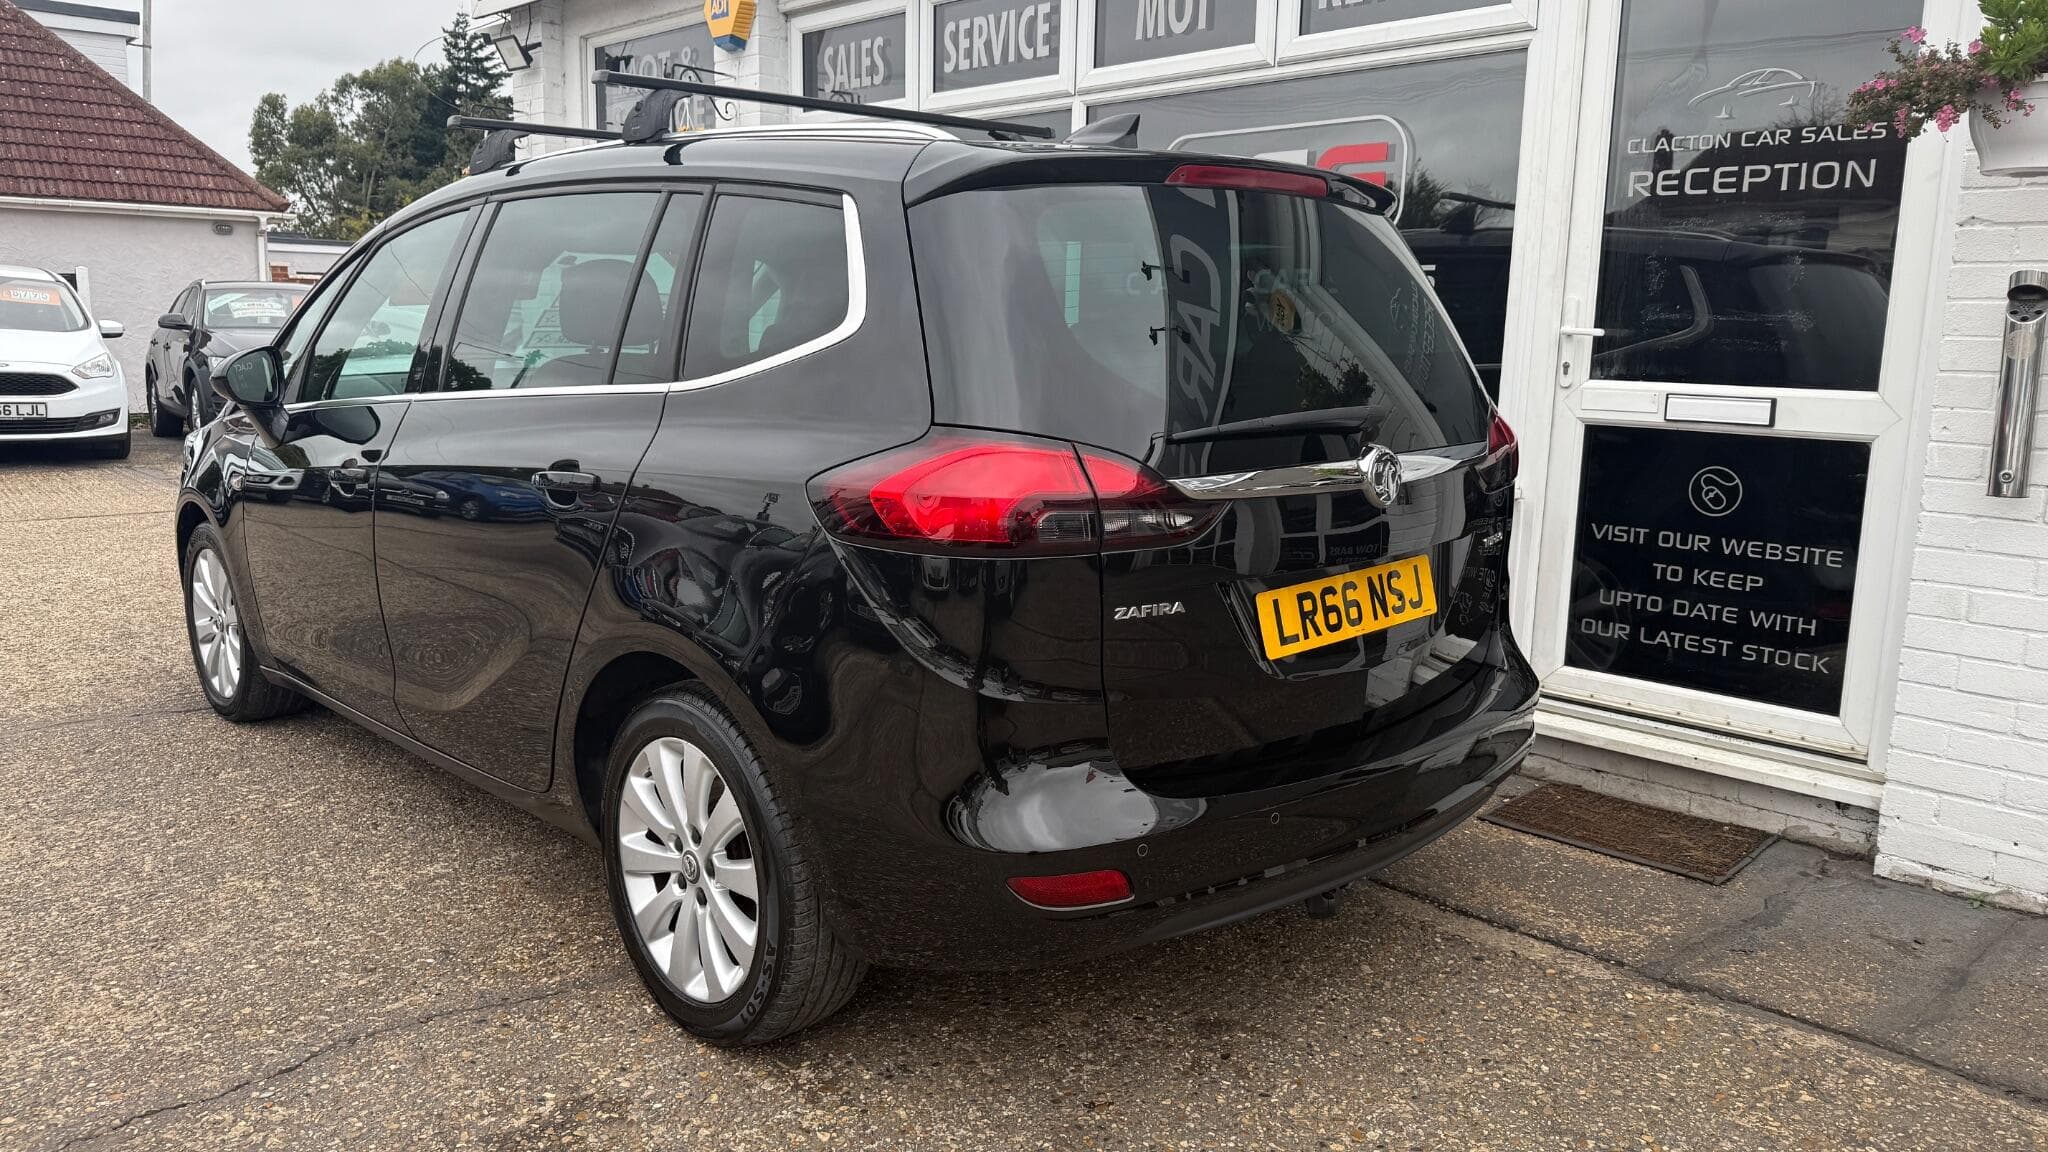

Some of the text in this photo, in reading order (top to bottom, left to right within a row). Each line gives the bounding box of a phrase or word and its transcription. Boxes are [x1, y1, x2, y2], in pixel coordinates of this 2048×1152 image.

[943, 2, 1051, 73] SERVICE
[823, 36, 885, 93] SALES
[1627, 122, 1888, 154] CLACTON CAR SALES
[1627, 158, 1877, 198] RECEPTION
[16, 404, 45, 416] LJL
[1591, 522, 1844, 568] VISIT OUR WEBSITE
[1652, 563, 1764, 592] TO KEEP
[1113, 601, 1186, 620] ZAFIRA
[1272, 564, 1424, 647] LR66 NSJ
[1599, 588, 1817, 637] UPTO DATE WITH
[1580, 617, 1830, 674] OUR LATEST STOCK
